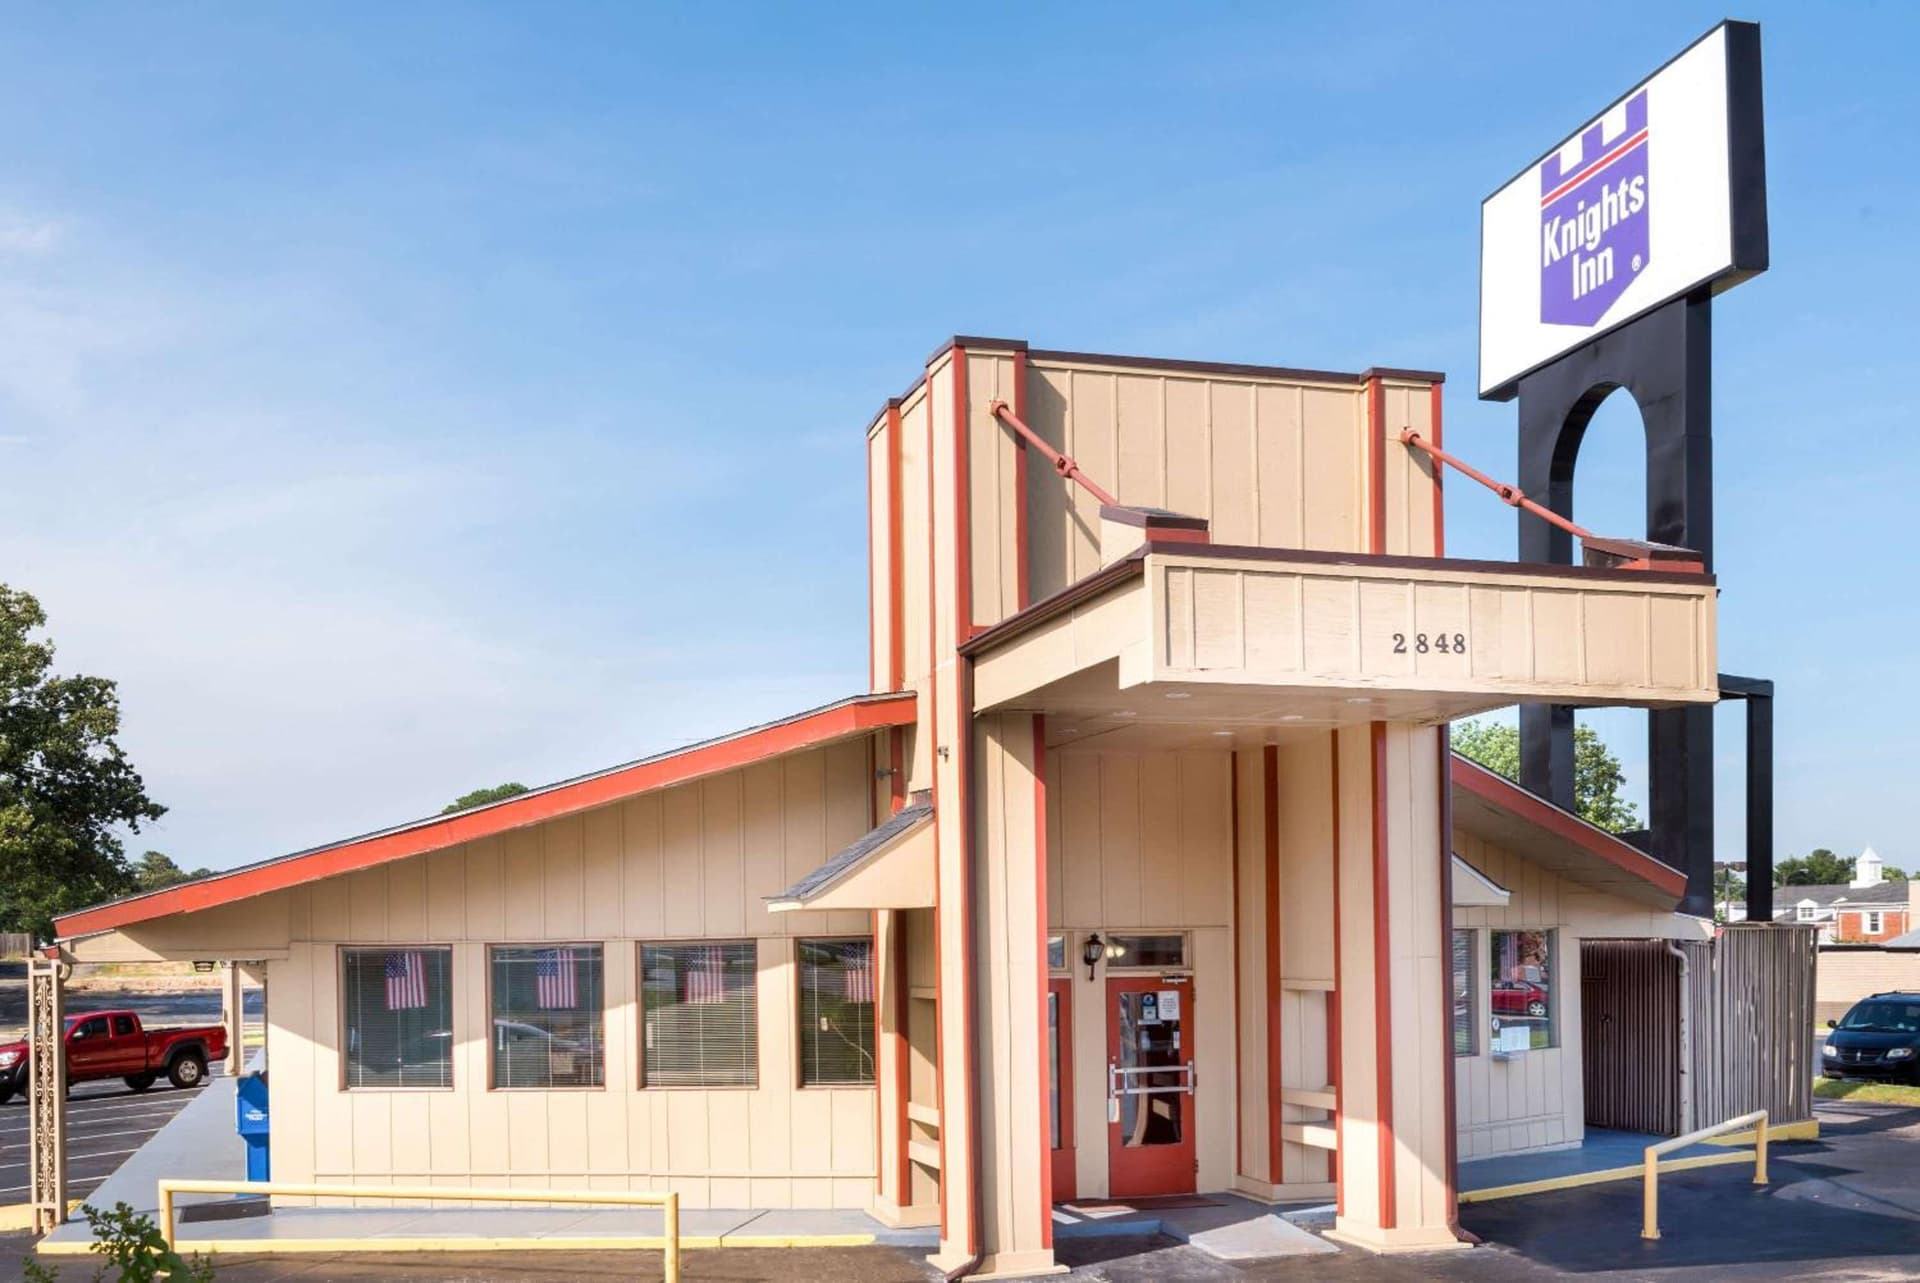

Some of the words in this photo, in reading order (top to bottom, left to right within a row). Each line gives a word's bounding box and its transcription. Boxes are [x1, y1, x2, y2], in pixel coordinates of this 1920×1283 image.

[1543, 174, 1645, 268] Knights
[1572, 247, 1614, 300] Inn
[1392, 633, 1466, 654] 2848
